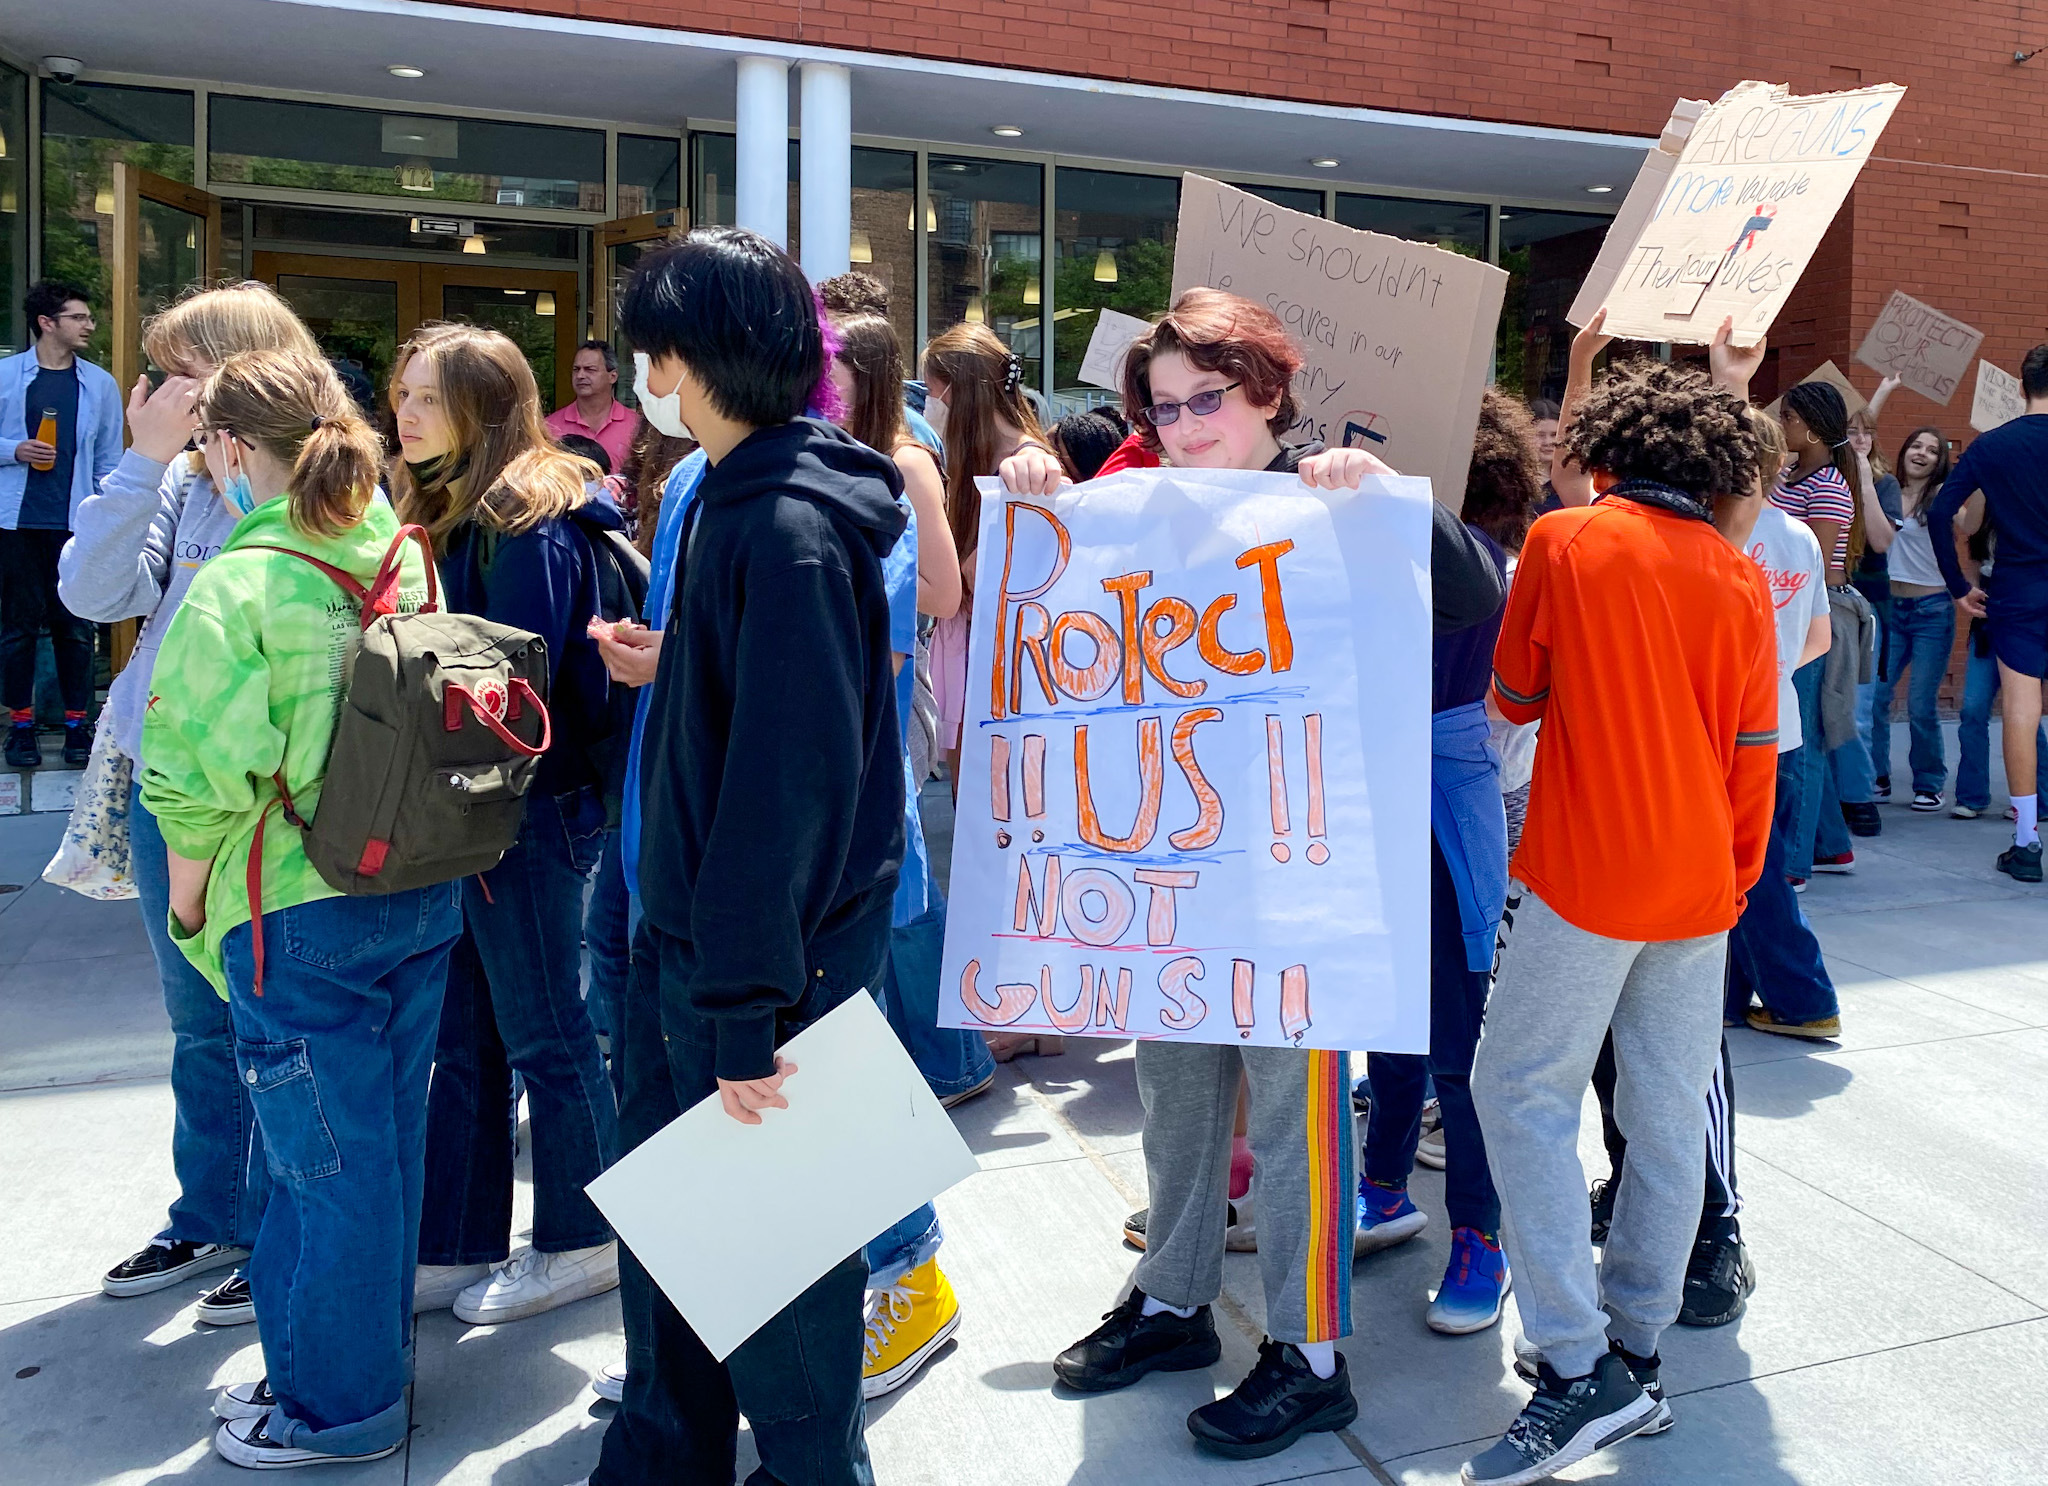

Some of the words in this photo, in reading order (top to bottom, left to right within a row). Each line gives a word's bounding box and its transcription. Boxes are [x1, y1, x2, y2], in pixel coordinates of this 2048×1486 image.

[1769, 102, 1884, 163] GUNS
[393, 164, 432, 188] 272
[1217, 193, 1276, 255] We
[1687, 259, 1716, 278] our
[1350, 331, 1367, 354] in
[1375, 345, 1403, 369] our
[1877, 320, 1931, 362] OUR
[1886, 295, 1976, 353] PROTECT
[1874, 345, 1955, 396] SCHOOLS
[1075, 708, 1225, 853] US
[1013, 854, 1200, 947] NOT
